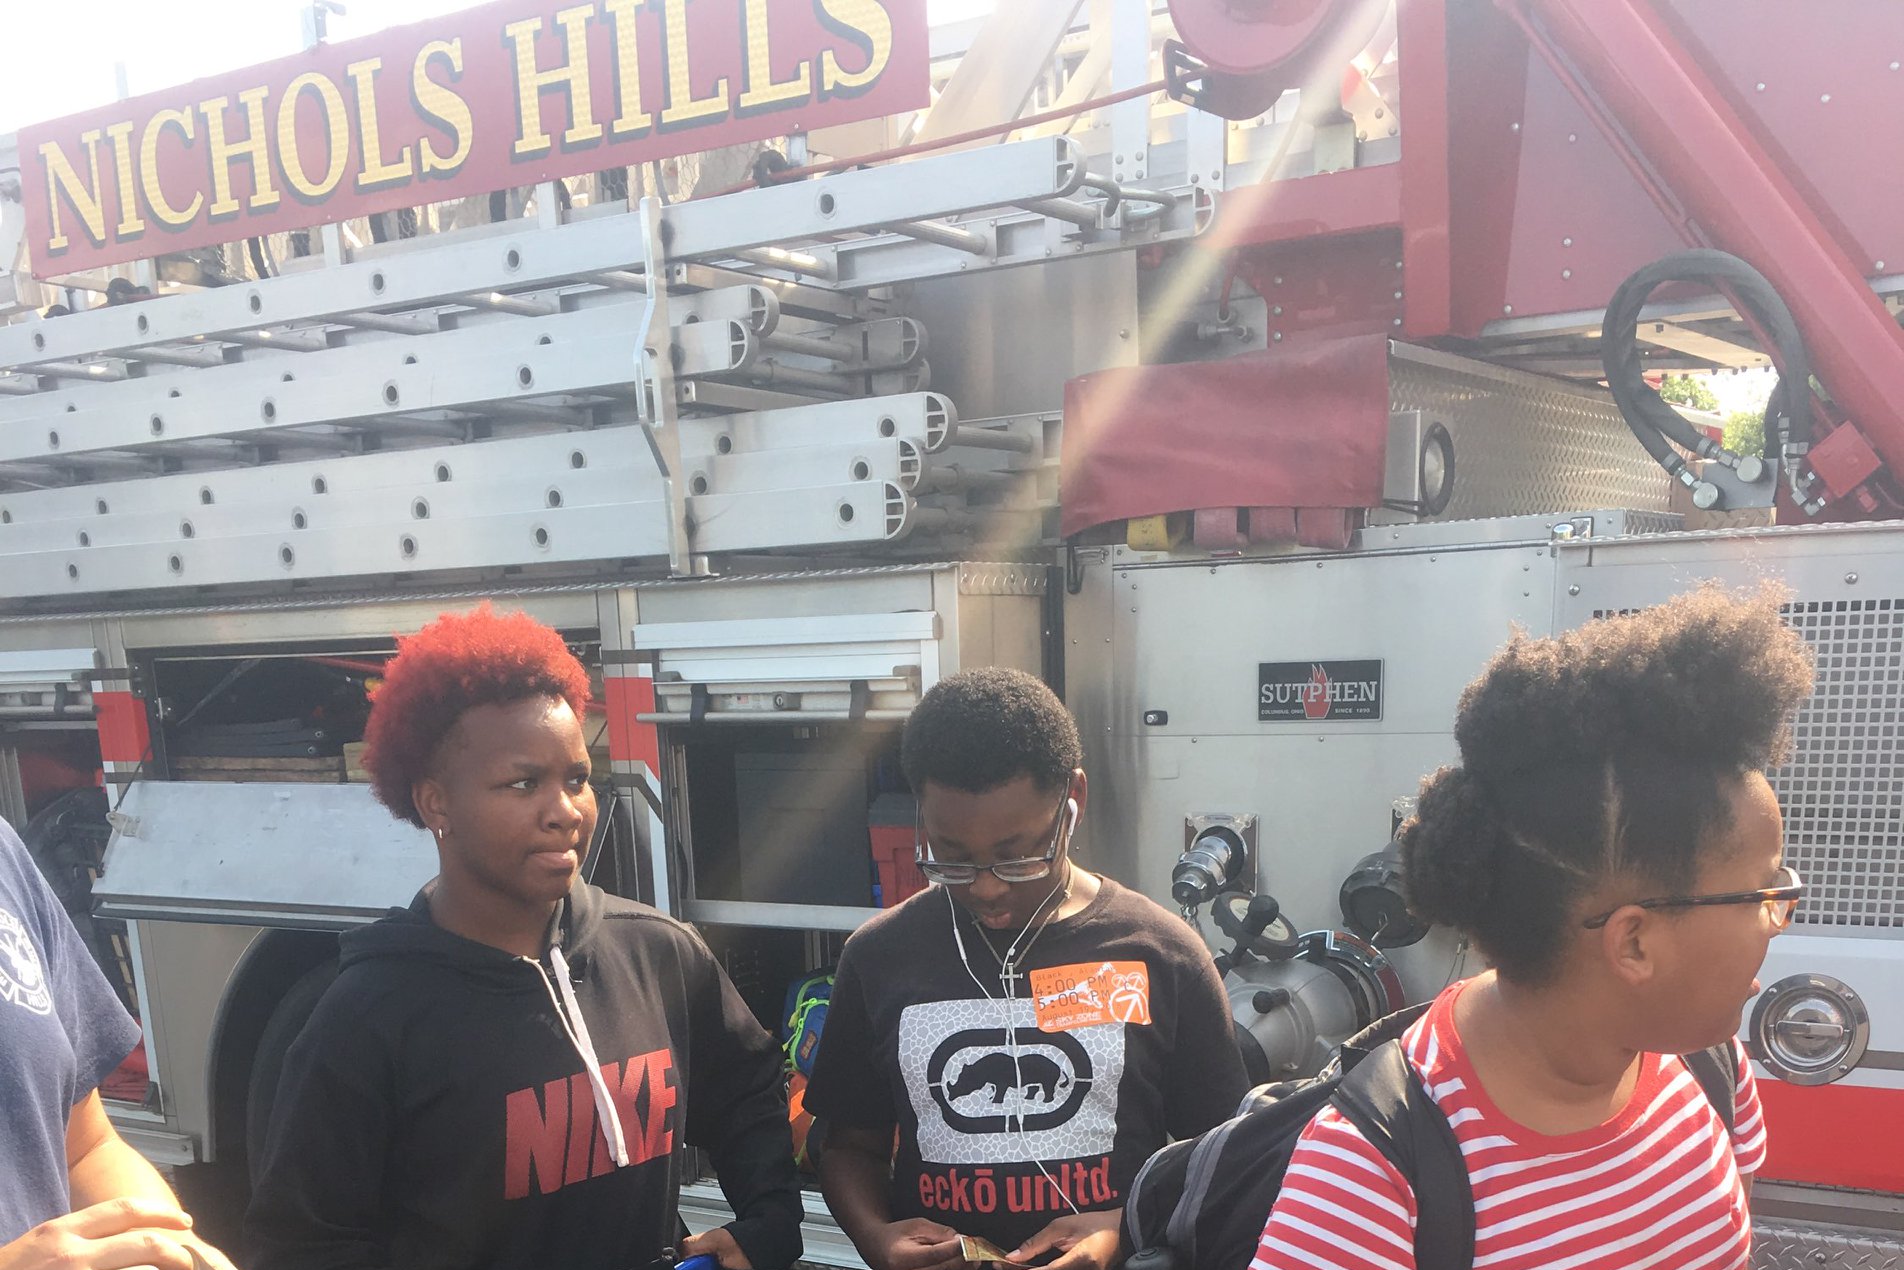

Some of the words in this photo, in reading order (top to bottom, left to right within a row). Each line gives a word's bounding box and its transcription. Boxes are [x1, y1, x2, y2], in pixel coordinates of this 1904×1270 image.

[36, 36, 475, 252] NICHOLS
[503, 0, 894, 157] HILLS
[1261, 681, 1378, 704] SUTPHEN
[1035, 978, 1076, 997] 4:00
[1087, 975, 1108, 989] PM
[1037, 991, 1079, 1012] 5:00
[1090, 990, 1111, 1002] PM
[504, 1048, 677, 1200] NIKE
[1006, 1156, 1119, 1214] unltd.
